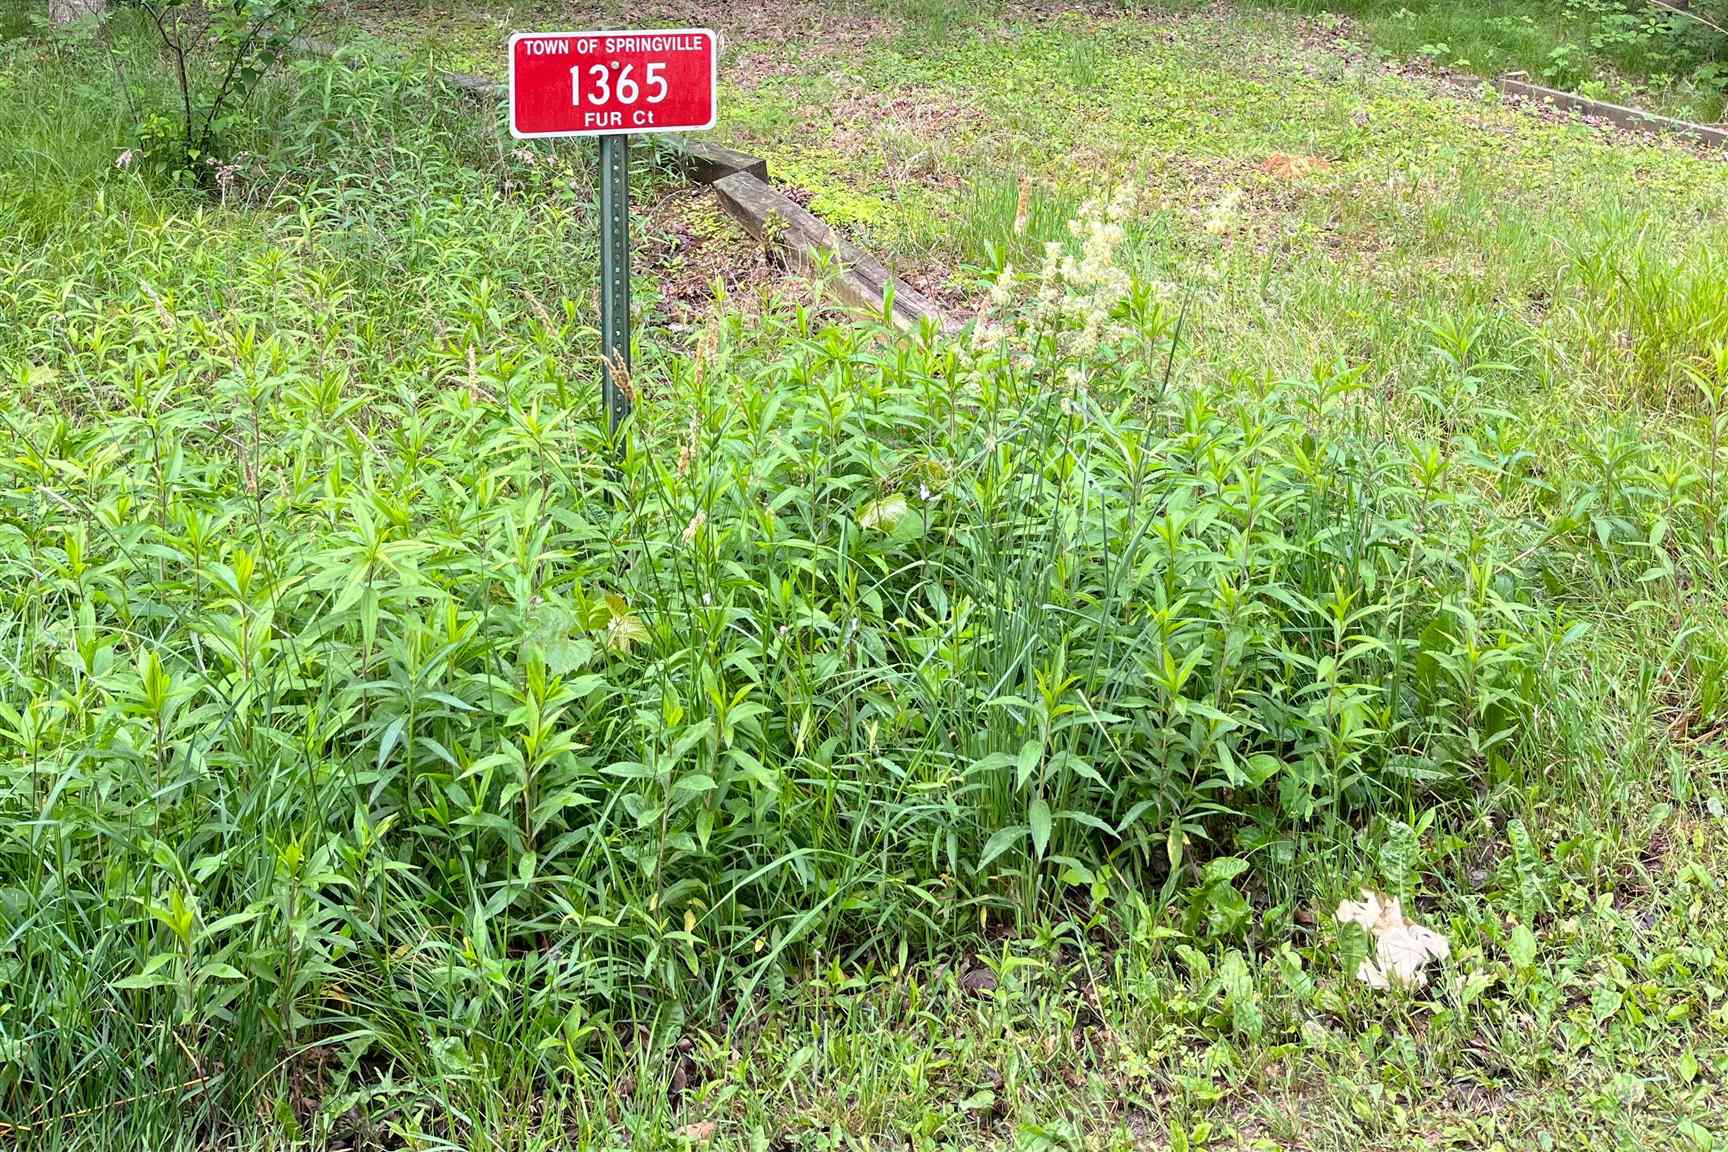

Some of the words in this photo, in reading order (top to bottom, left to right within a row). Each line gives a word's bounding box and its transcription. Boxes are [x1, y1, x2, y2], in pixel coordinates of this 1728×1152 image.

[524, 40, 569, 56] TOWN
[577, 38, 598, 54] OF
[605, 36, 702, 53] SPRINGVILLE
[569, 62, 668, 106] 1365
[584, 112, 622, 127] FUR
[633, 110, 654, 125] Ct
